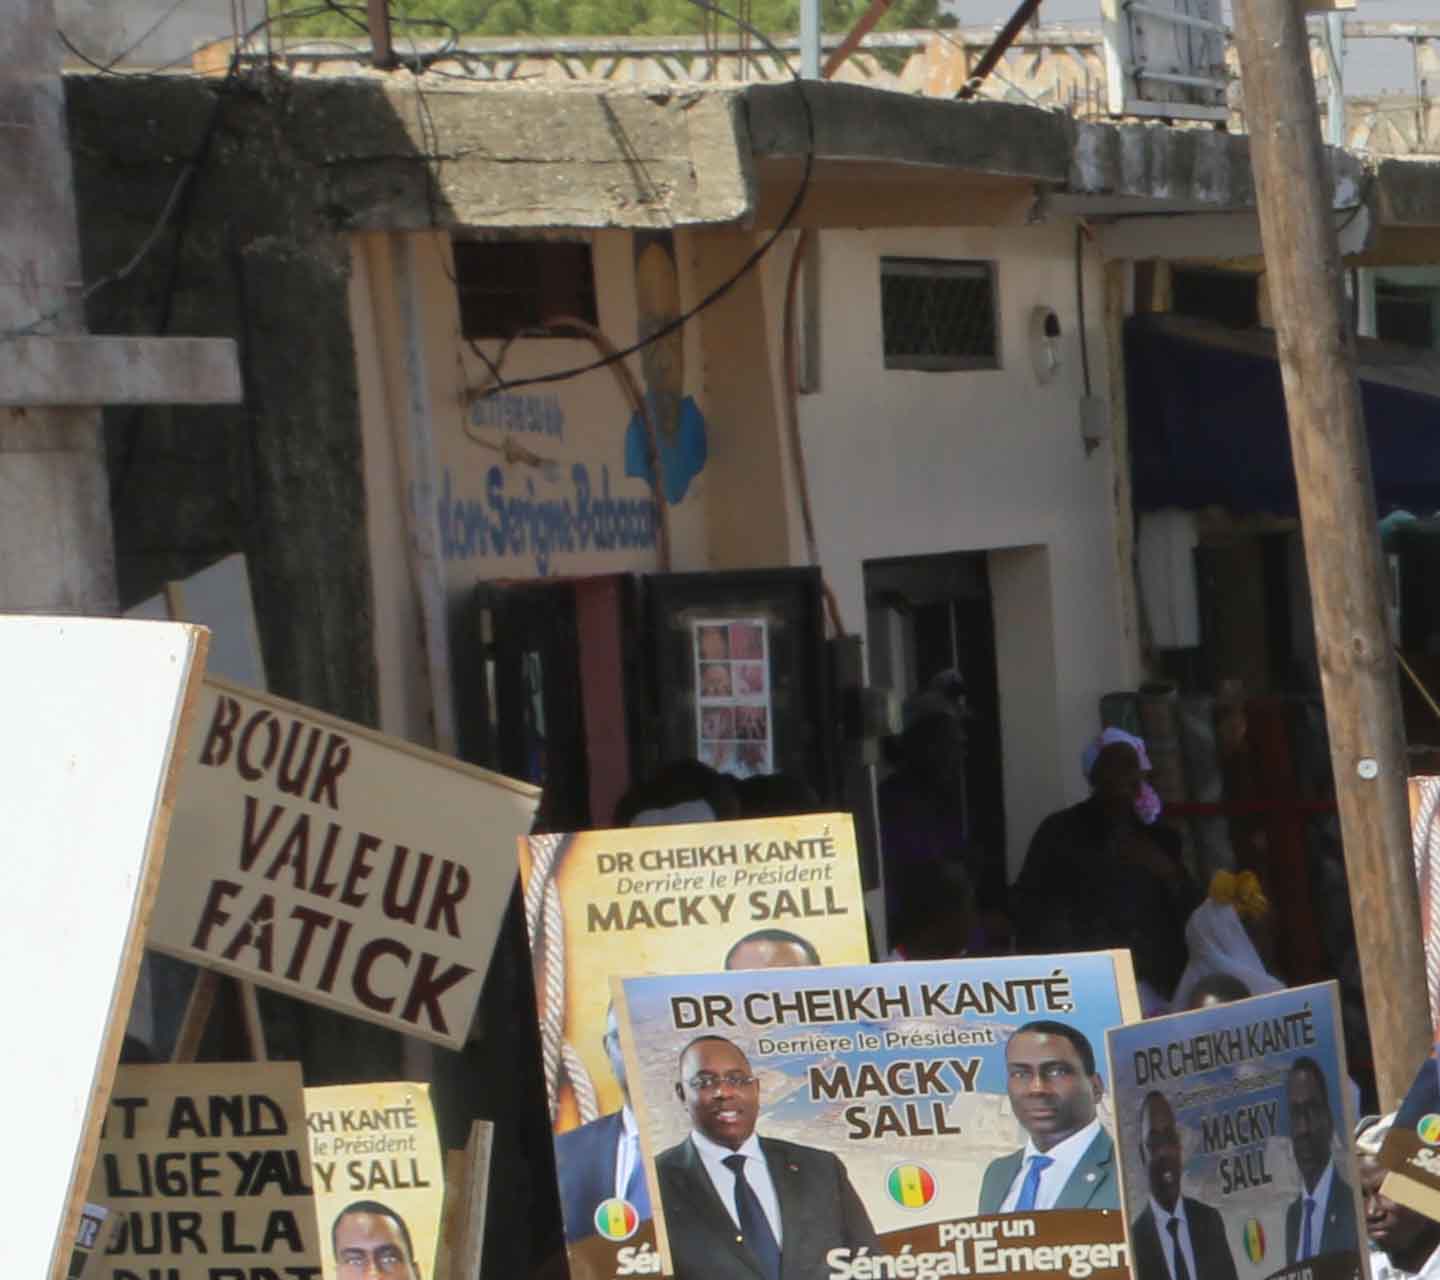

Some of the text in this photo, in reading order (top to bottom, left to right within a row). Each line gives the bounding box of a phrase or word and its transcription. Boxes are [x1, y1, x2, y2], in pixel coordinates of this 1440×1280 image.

[198, 693, 352, 810] BOUR
[238, 794, 471, 939] VALEUR
[597, 851, 635, 876] DR
[638, 843, 741, 873] CHEIKH
[615, 863, 834, 898] Derrière le Président
[586, 885, 850, 935] MACKY SALL
[191, 878, 476, 1035] FATICK
[670, 967, 1074, 1031] DR CHEIKH KANTÉ
[757, 1026, 996, 1057] Derrière le Président
[1133, 1001, 1317, 1088] DR CHEIKH KANTÉ
[806, 1056, 986, 1103] MACKY
[166, 1094, 288, 1139] AND
[846, 1100, 962, 1141] SALL
[1199, 1095, 1280, 1152] MACKY
[332, 1134, 418, 1156] Président
[348, 1157, 431, 1192] SALL
[1219, 1151, 1273, 1195] SALL
[220, 1209, 305, 1256] LA
[937, 1214, 1036, 1247] pour un
